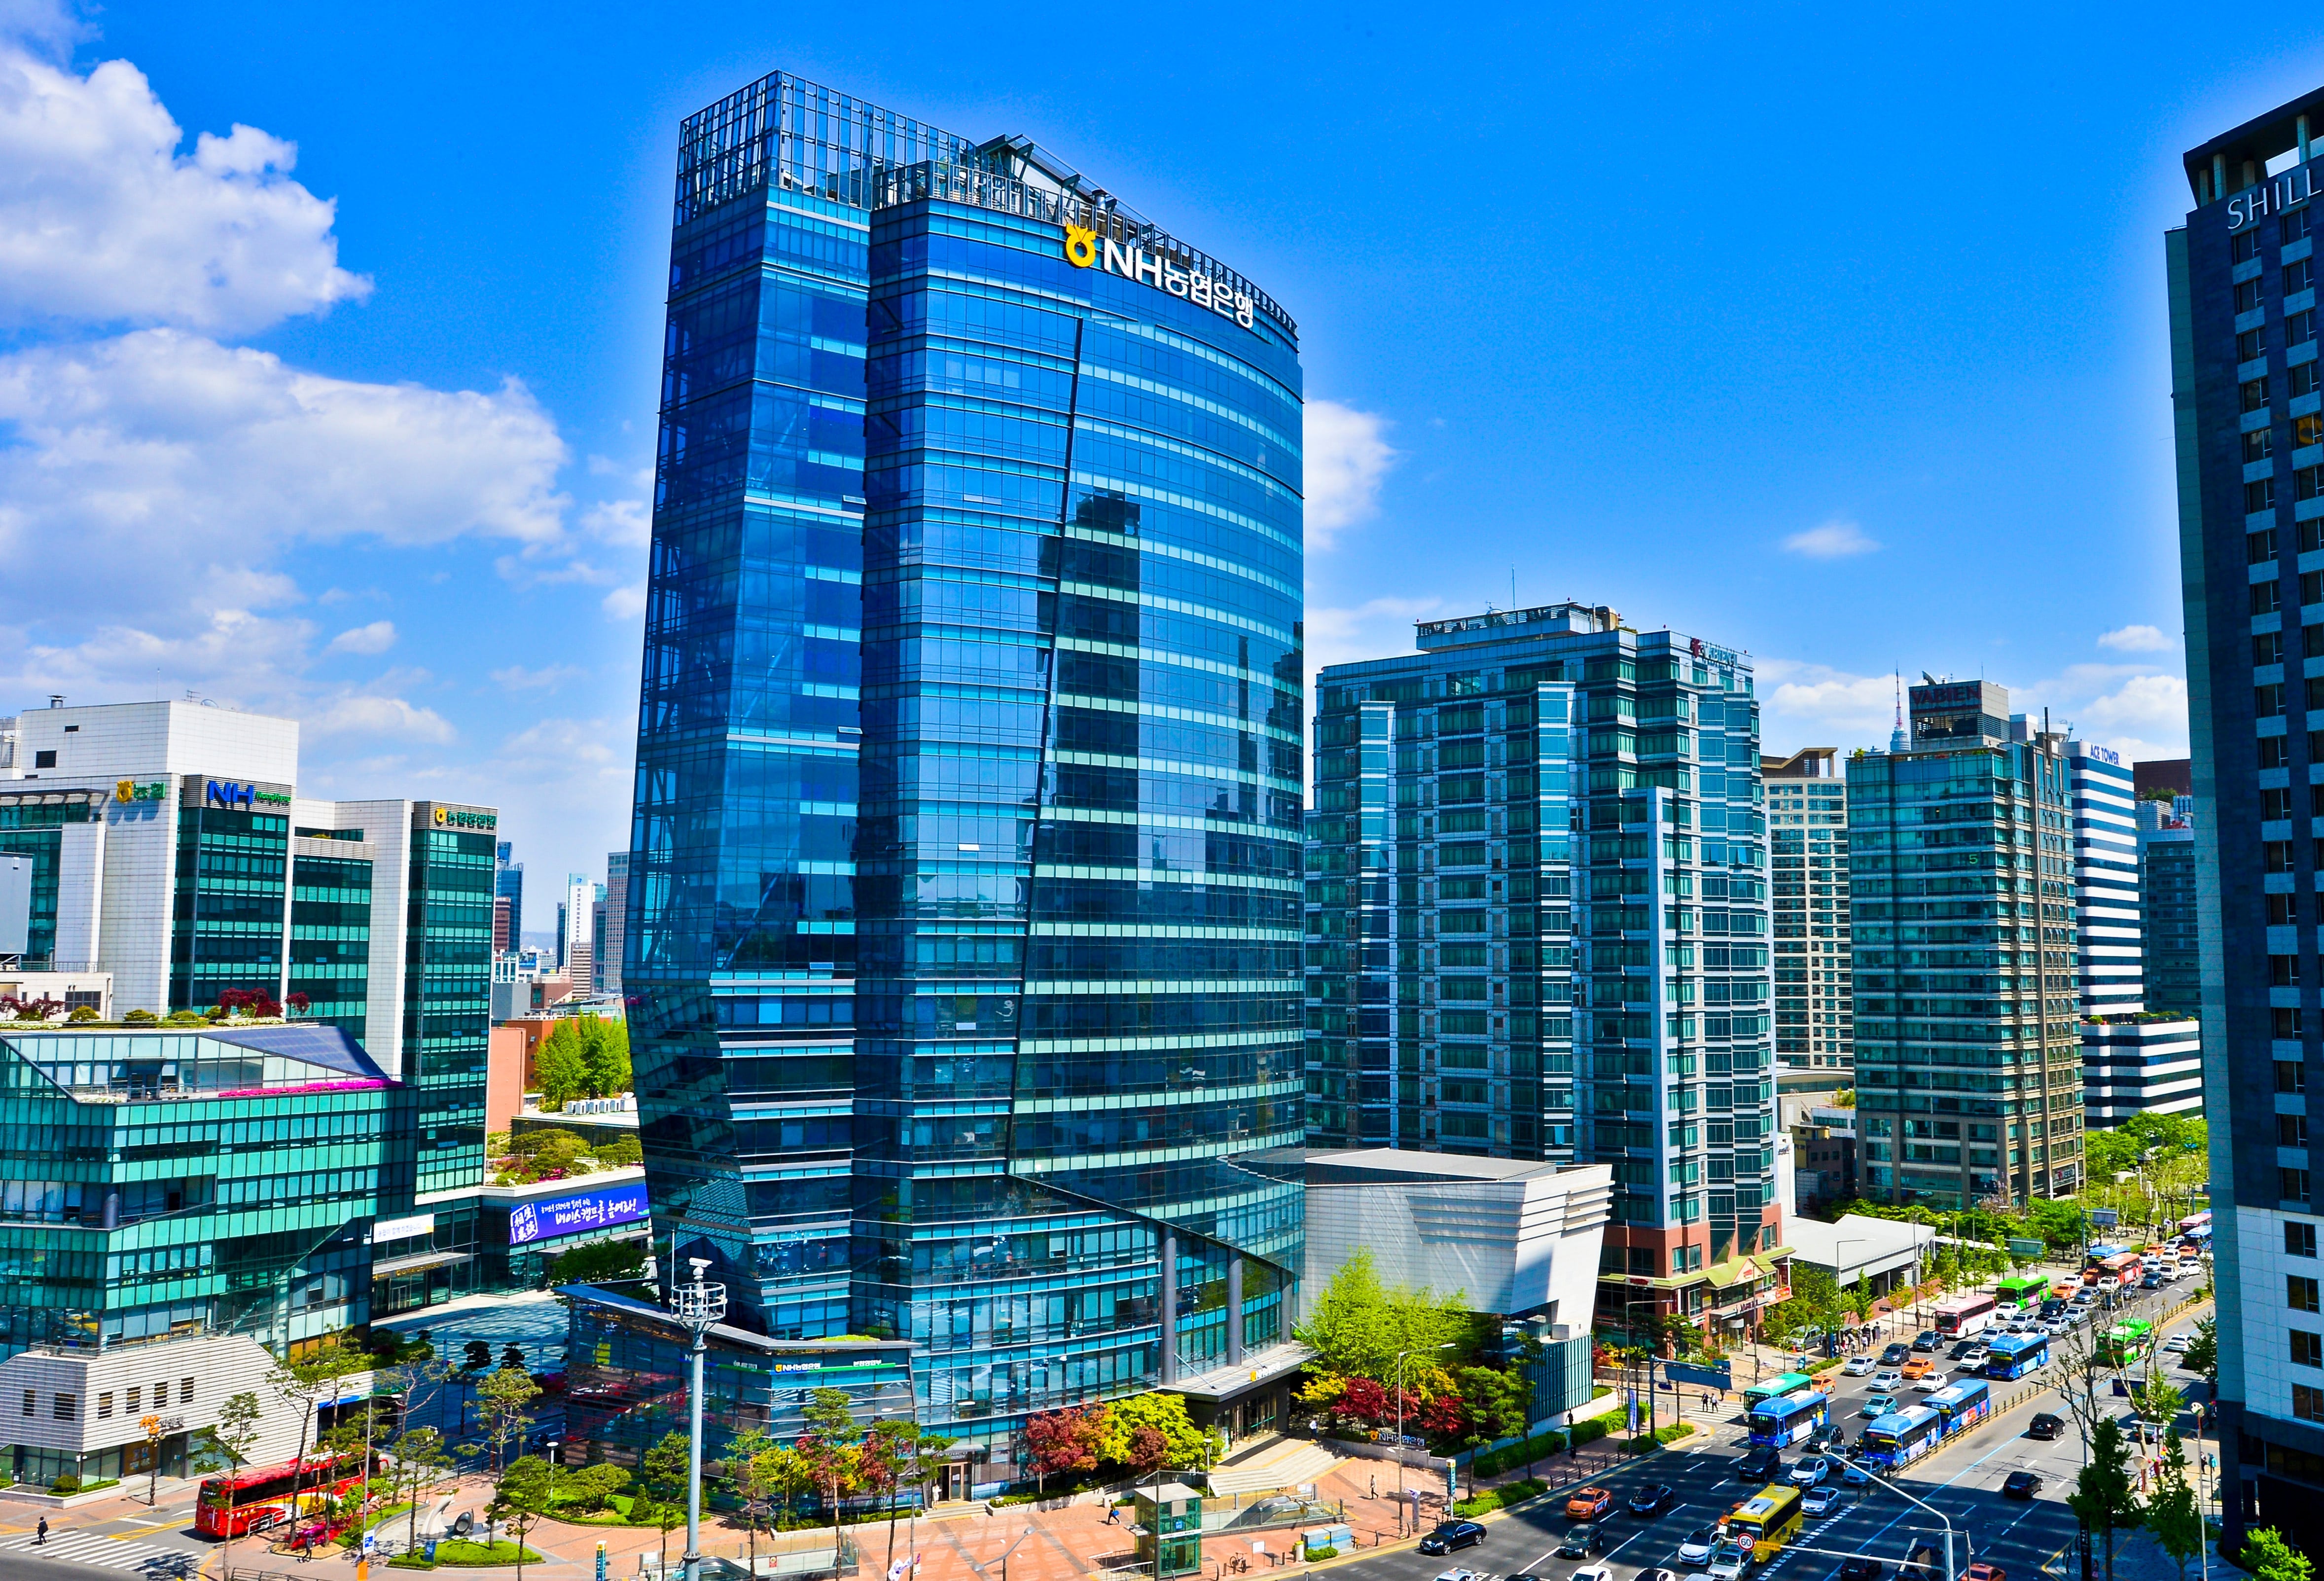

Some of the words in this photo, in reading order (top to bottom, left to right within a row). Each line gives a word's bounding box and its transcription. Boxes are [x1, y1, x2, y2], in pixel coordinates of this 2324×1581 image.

[2227, 168, 2322, 229] SHILL
[1104, 238, 1254, 329] NH농협은행
[1911, 682, 1982, 705] VABIEN
[2090, 744, 2100, 760] ACE
[2101, 747, 2119, 766] TOWER
[133, 781, 166, 799] 농협
[207, 780, 255, 805] NH
[555, 1200, 606, 1225] 베이스캠프를
[608, 1198, 637, 1219] 높여라!
[782, 1363, 821, 1372] NH농협은행
[1741, 1538, 1752, 1546] 60
